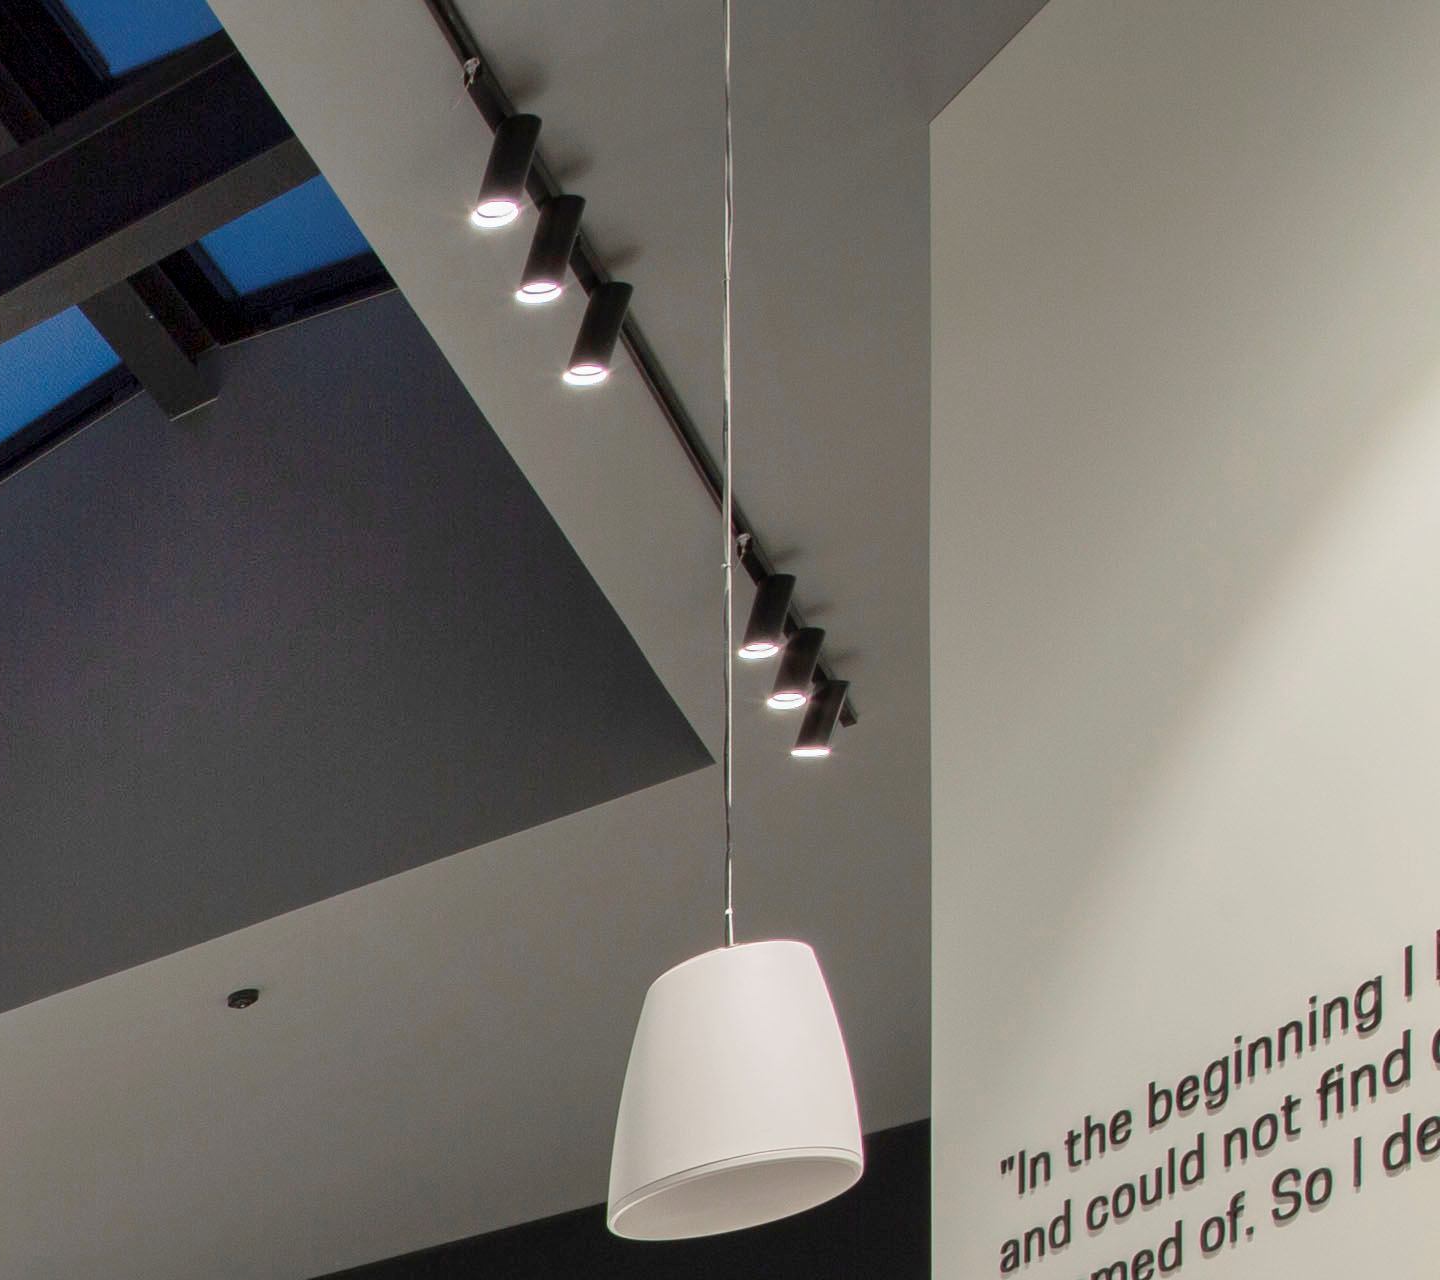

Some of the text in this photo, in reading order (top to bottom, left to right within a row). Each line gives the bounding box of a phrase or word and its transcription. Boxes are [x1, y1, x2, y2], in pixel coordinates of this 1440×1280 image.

[1000, 1199, 1070, 1272] and
[1087, 1133, 1204, 1230] could
[1224, 1095, 1300, 1167] not
[1317, 1030, 1410, 1121] find
[1001, 1151, 1050, 1194] "In
[1065, 1110, 1131, 1167] the
[1149, 976, 1381, 1128] beginning
[1405, 946, 1413, 996] I
[1201, 1191, 1254, 1252] of.
[1272, 1168, 1332, 1220] So
[1354, 1137, 1362, 1187] I
